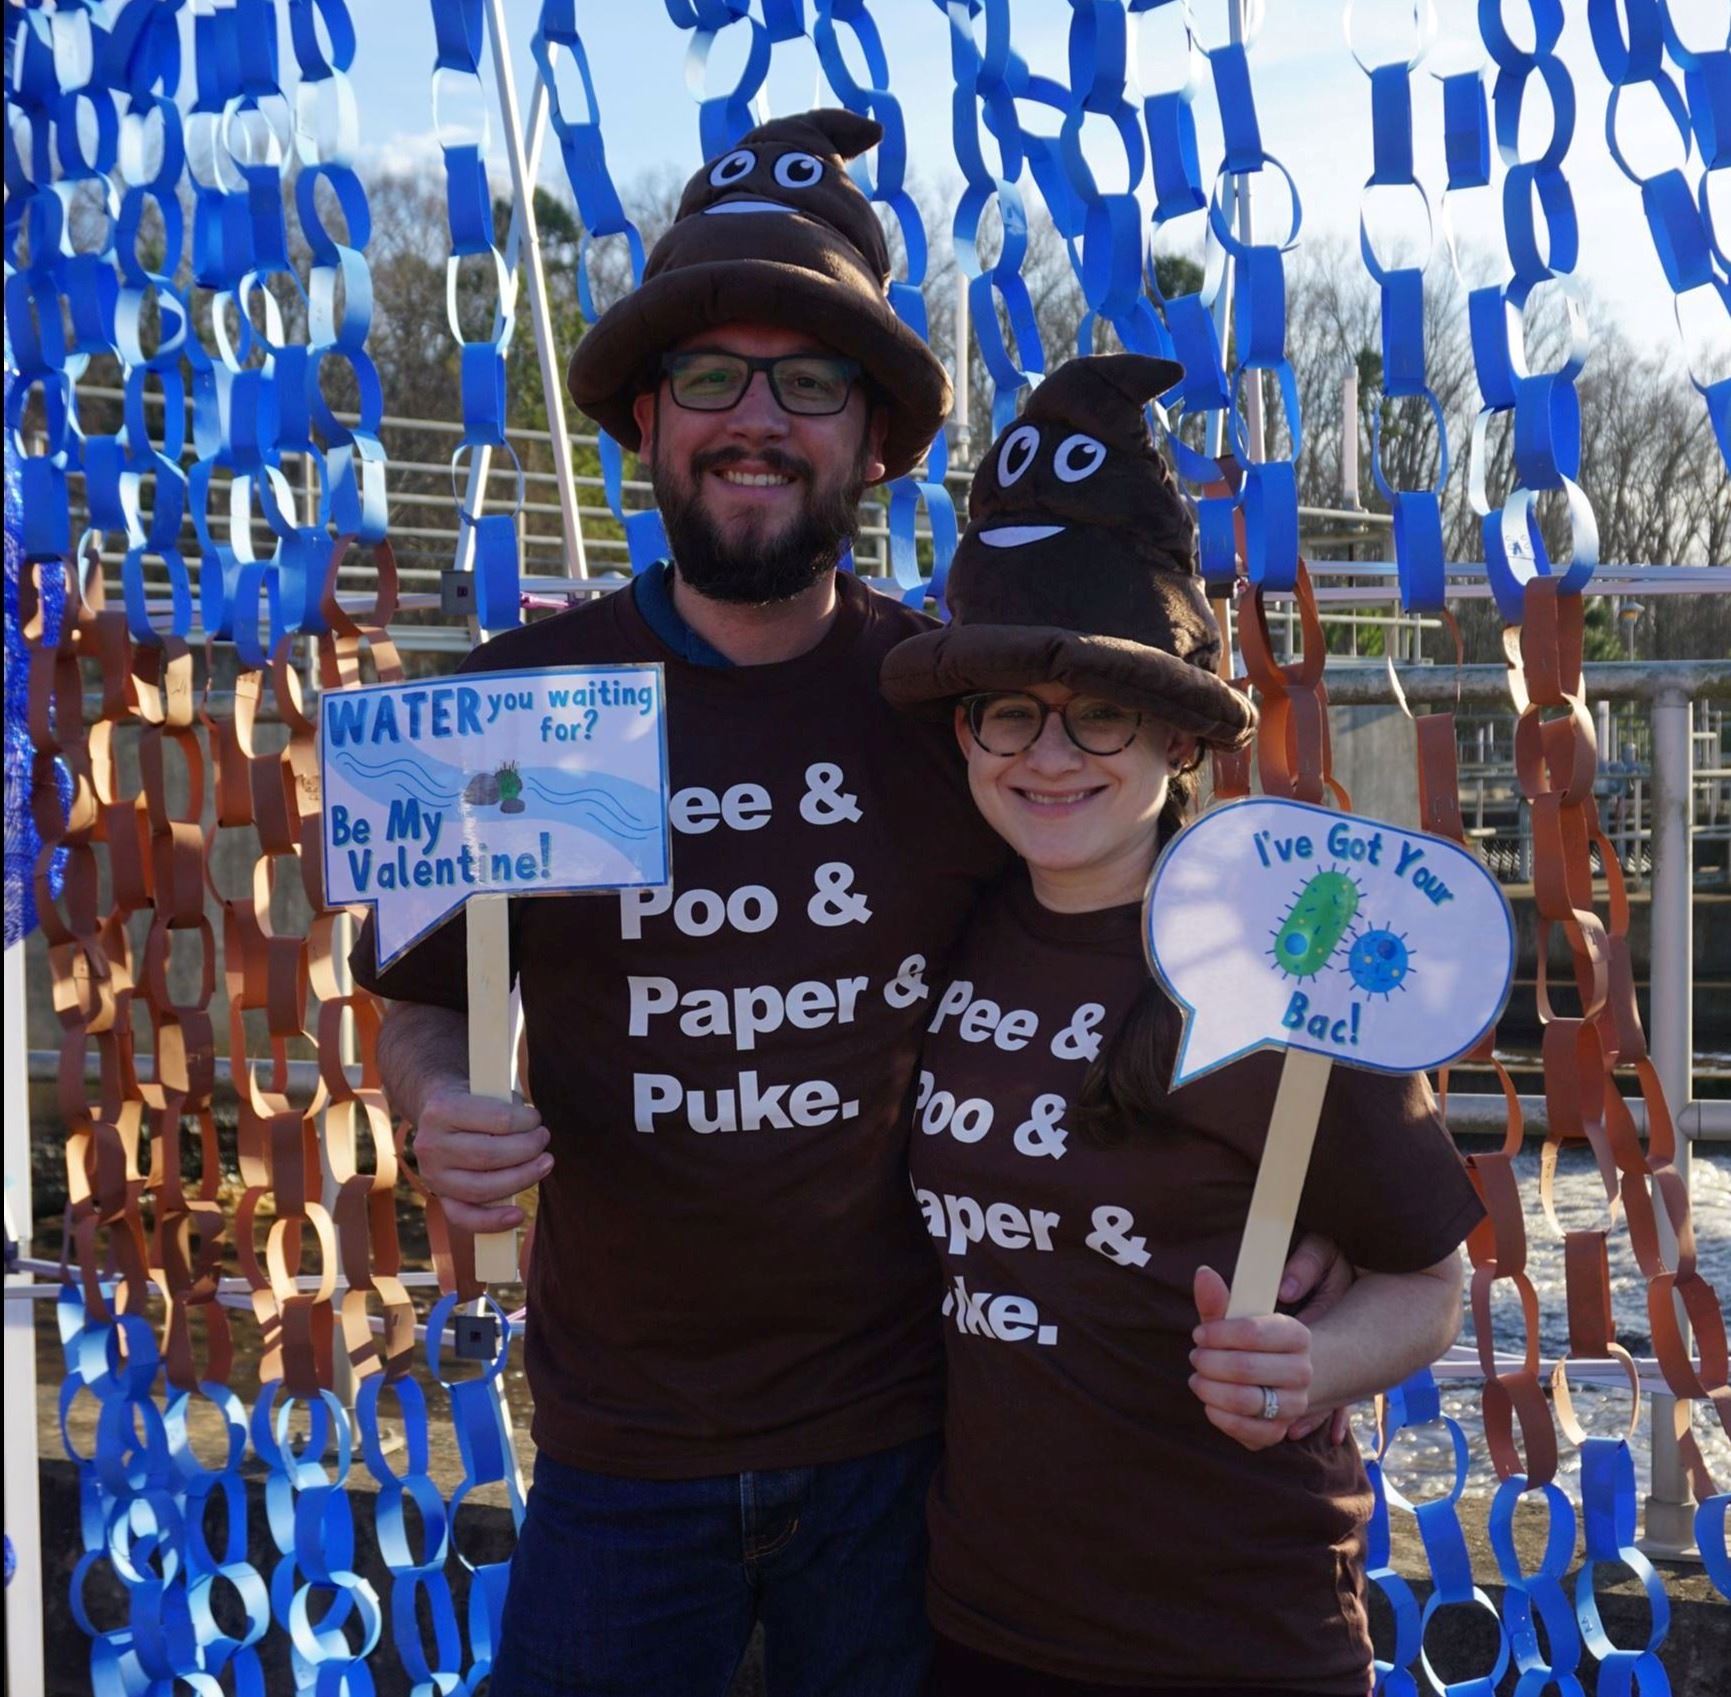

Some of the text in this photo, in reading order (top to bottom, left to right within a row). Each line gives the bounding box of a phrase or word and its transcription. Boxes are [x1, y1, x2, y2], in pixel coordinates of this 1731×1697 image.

[327, 680, 651, 749] WATER you waiting
[541, 709, 598, 742] for?
[331, 798, 443, 856] Be My
[671, 763, 863, 834] ee &
[346, 830, 553, 892] Valentine!
[1254, 821, 1455, 905] I've Got Your
[619, 862, 872, 939] Poo &
[628, 954, 928, 1050] Paper &
[926, 981, 1105, 1062] Pee &
[1279, 991, 1361, 1045] Bac!
[634, 1071, 859, 1133] Puke.
[1014, 1094, 1068, 1159] &
[917, 1189, 1151, 1267] aper &
